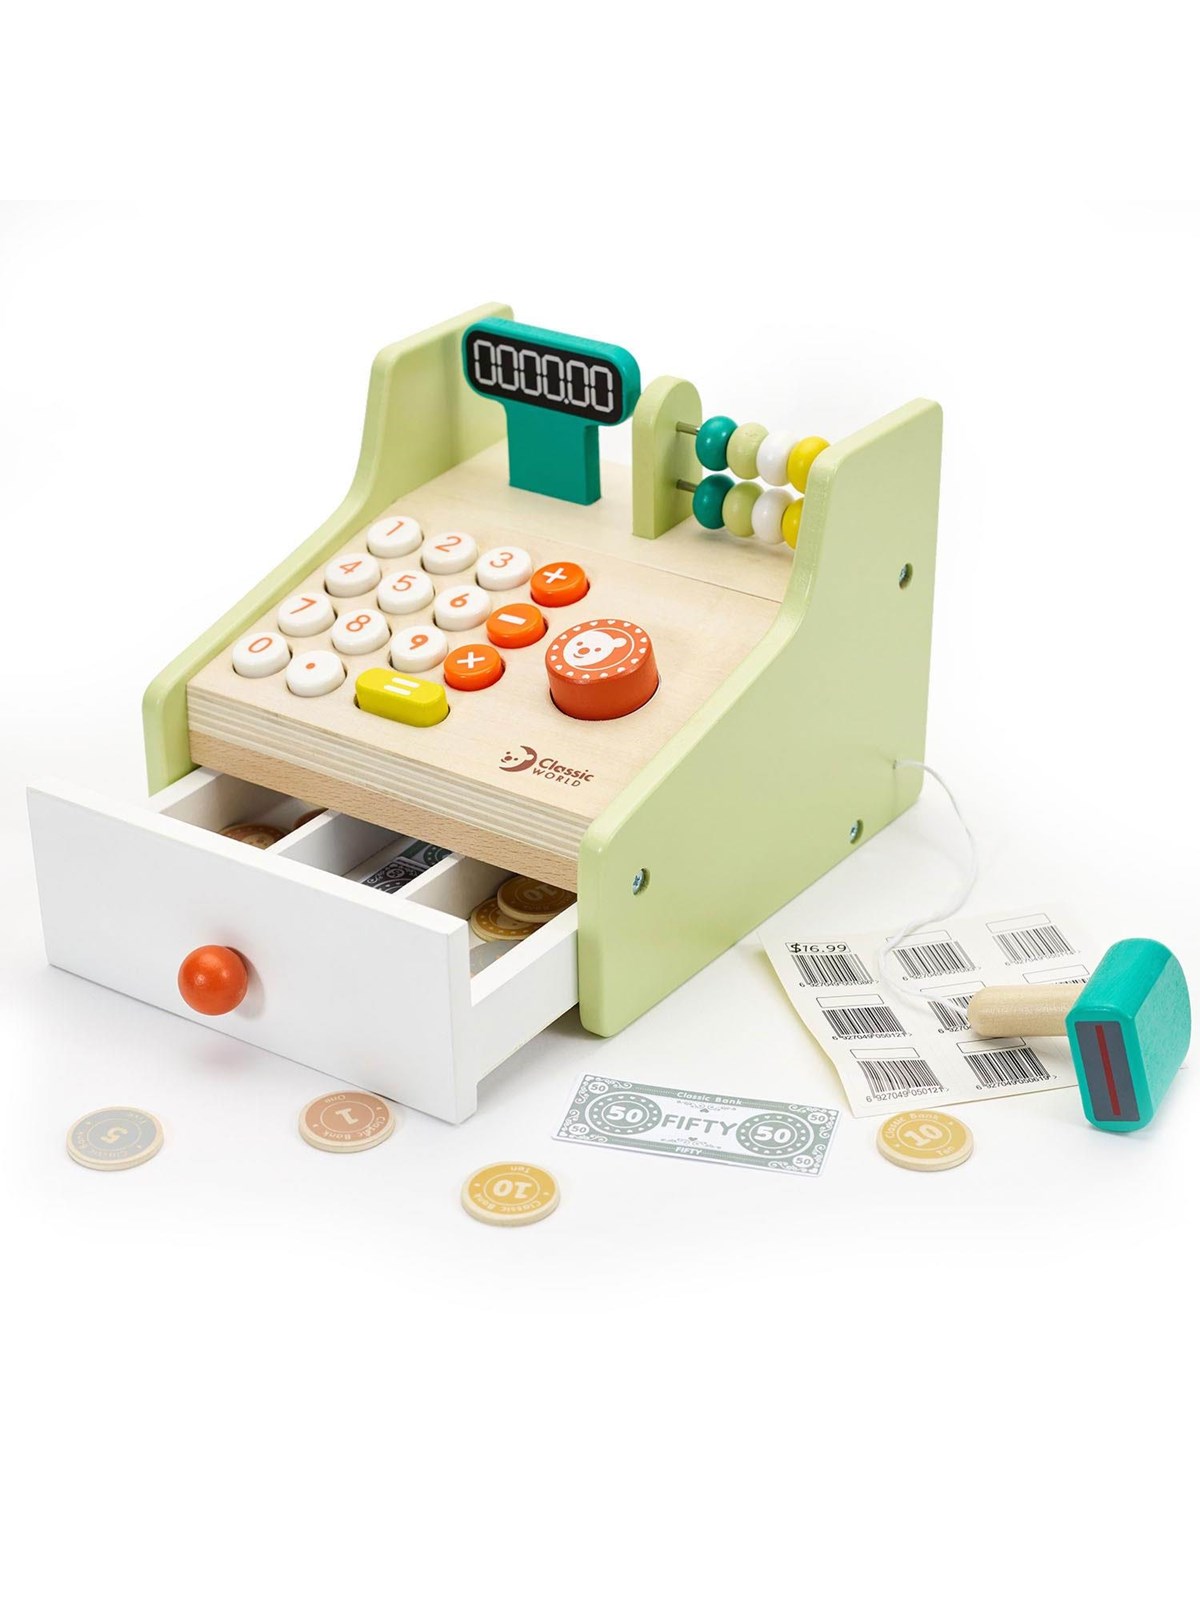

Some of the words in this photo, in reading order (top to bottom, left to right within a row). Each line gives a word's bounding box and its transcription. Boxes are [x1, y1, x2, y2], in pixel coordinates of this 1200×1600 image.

[386, 520, 405, 536] 1
[435, 535, 461, 552] 2
[339, 560, 363, 574] 4
[489, 552, 514, 569] 3
[392, 574, 417, 592] 5
[289, 597, 317, 615] 7
[449, 593, 471, 609] 6
[345, 614, 371, 633] 8
[248, 637, 273, 653] 0
[409, 634, 429, 650] 9
[532, 767, 581, 787] WORLD
[539, 758, 595, 782] Classic
[790, 942, 848, 954] $16.99
[590, 1083, 607, 1093] 50
[677, 1091, 711, 1103] Classic
[715, 1096, 743, 1106] Bank
[335, 1108, 359, 1125] 1
[605, 1105, 643, 1123] 50
[810, 1113, 827, 1123] 50
[571, 1124, 587, 1134] 50
[661, 1113, 740, 1136] FIFTY
[100, 1126, 128, 1144] 5
[755, 1125, 792, 1143] 50
[904, 1124, 943, 1147] 10
[675, 1146, 702, 1156] FIFTY
[795, 1156, 812, 1166] 50
[492, 1179, 533, 1199] 10
